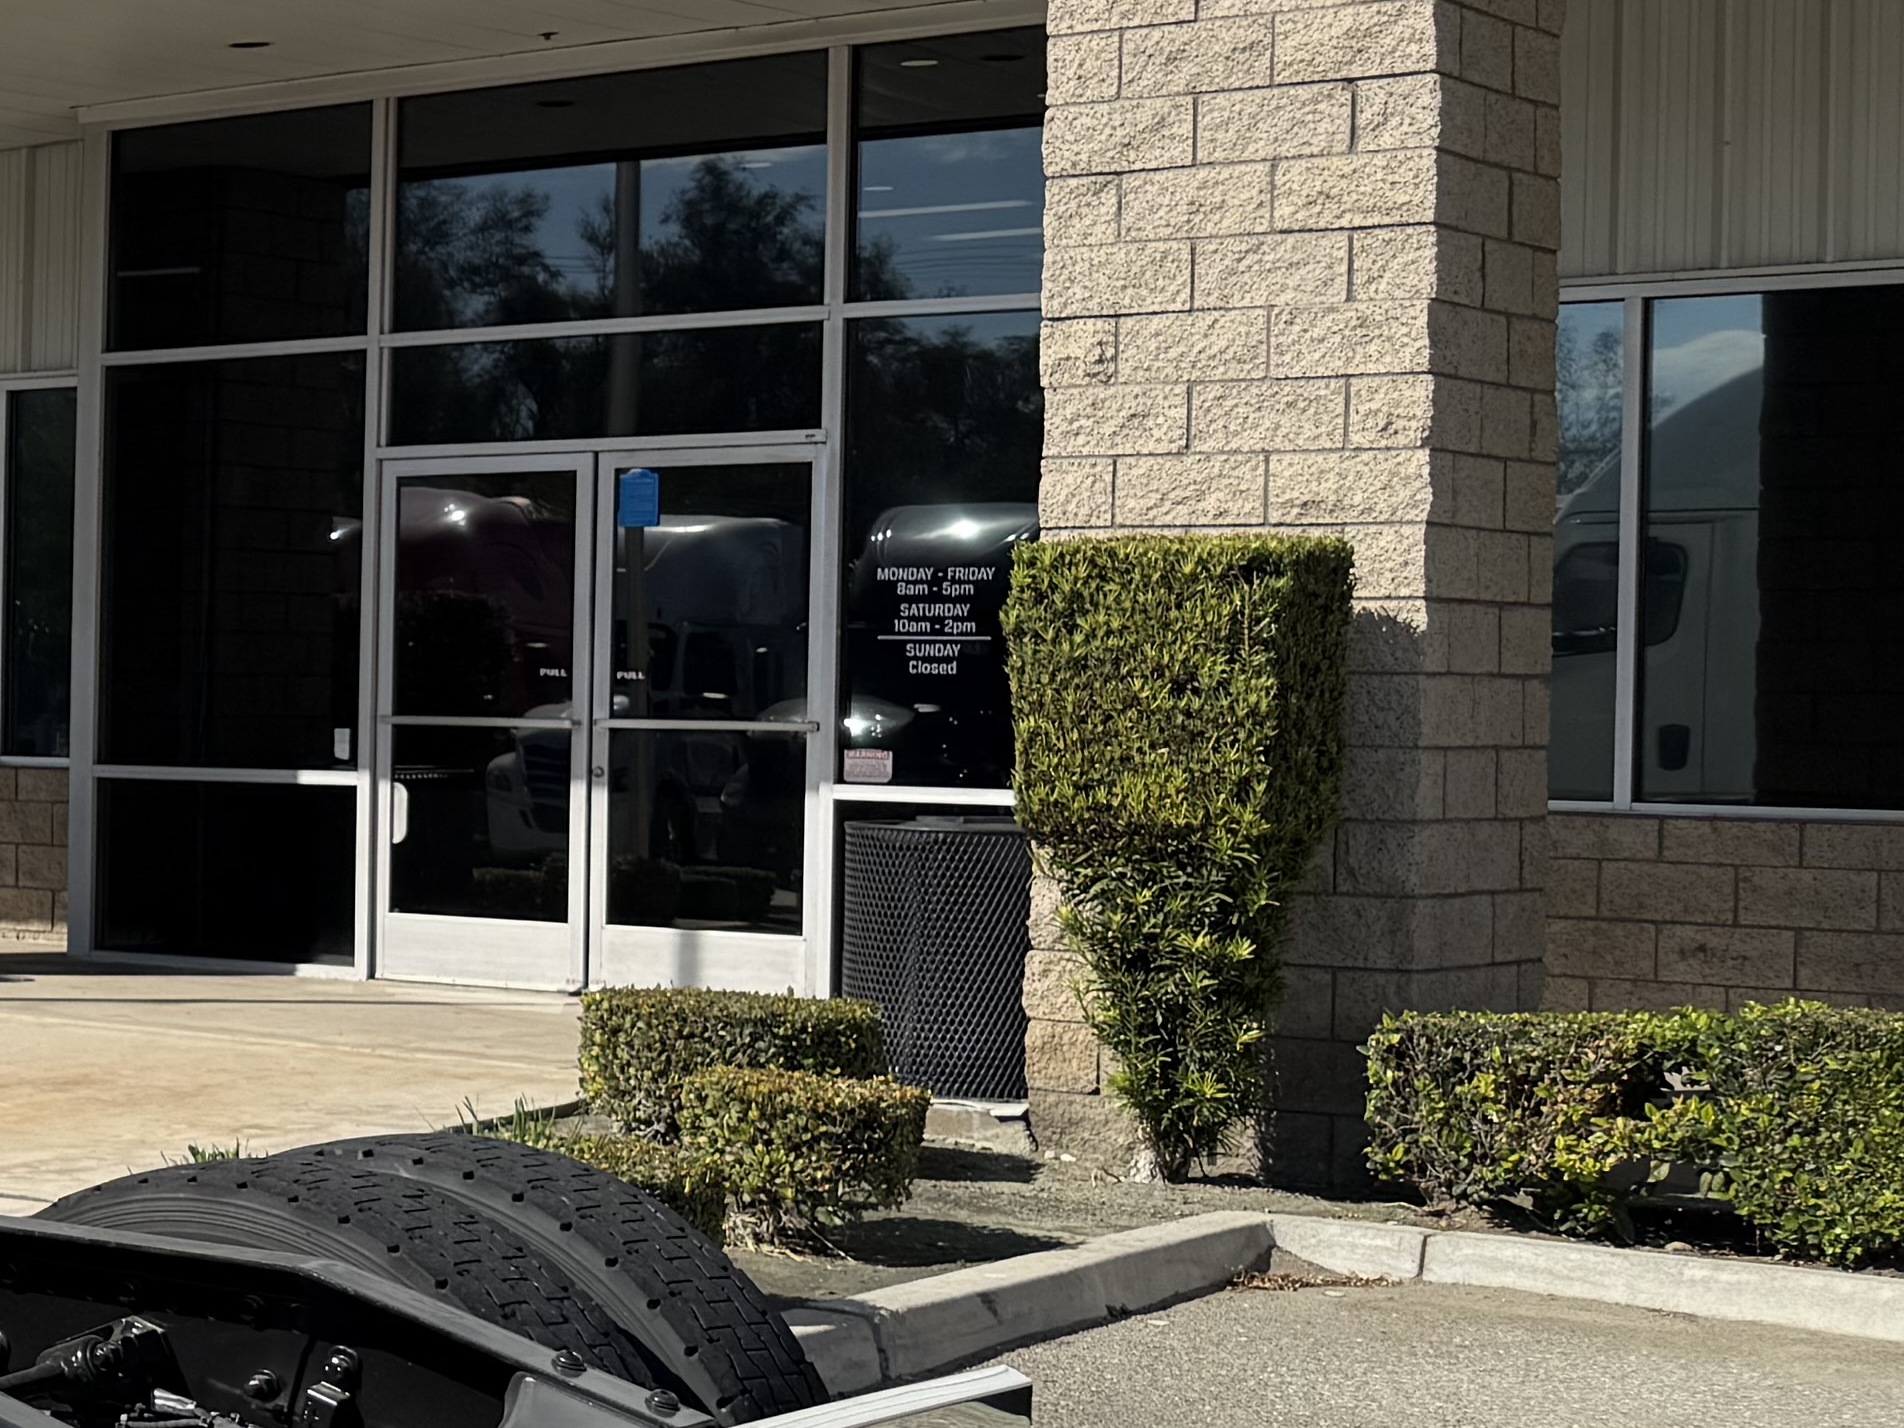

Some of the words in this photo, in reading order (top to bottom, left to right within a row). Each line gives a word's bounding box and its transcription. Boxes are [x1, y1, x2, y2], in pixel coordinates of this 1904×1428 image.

[876, 567, 934, 581] MONDAY
[947, 567, 996, 581] FRIDAY
[896, 581, 929, 595] 8am
[941, 581, 974, 598] 5pm
[899, 603, 970, 617] SATURDAY
[894, 618, 931, 633] 10am
[943, 619, 976, 635] 2pm
[905, 643, 961, 657] SUNDAY
[539, 668, 568, 677] PULL
[908, 660, 957, 674] Closed
[616, 671, 646, 680] PULL
